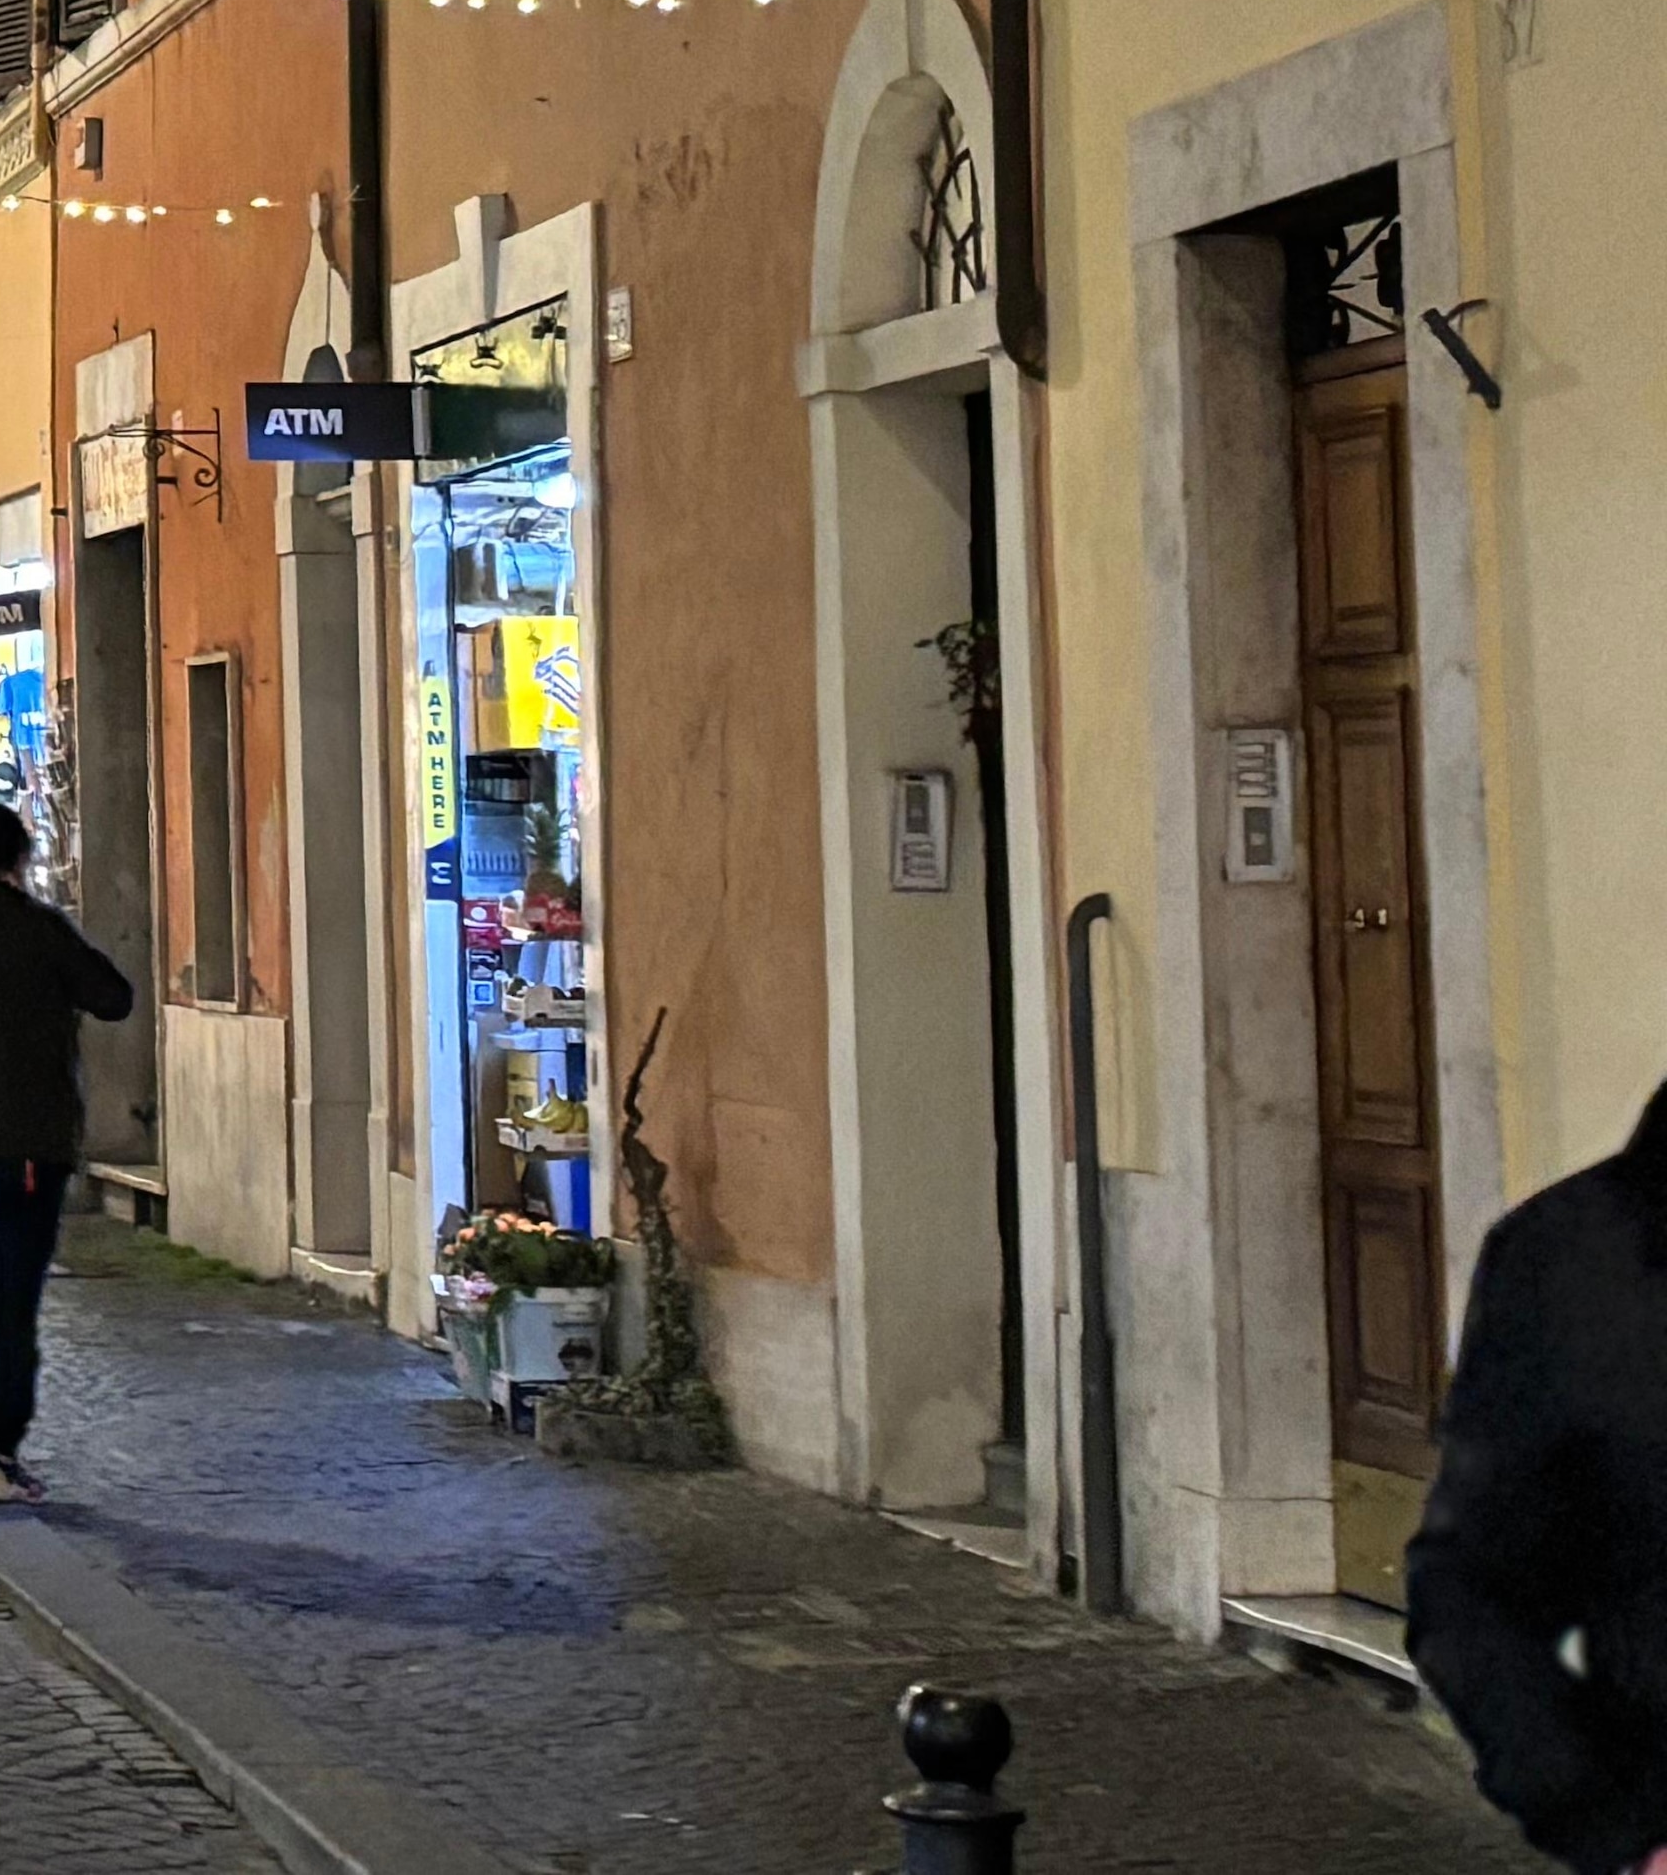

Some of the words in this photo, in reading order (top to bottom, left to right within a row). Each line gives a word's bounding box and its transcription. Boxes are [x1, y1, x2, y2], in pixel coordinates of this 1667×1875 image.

[264, 408, 343, 435] ATM
[427, 692, 445, 746] ATM
[431, 756, 445, 829] HERE
